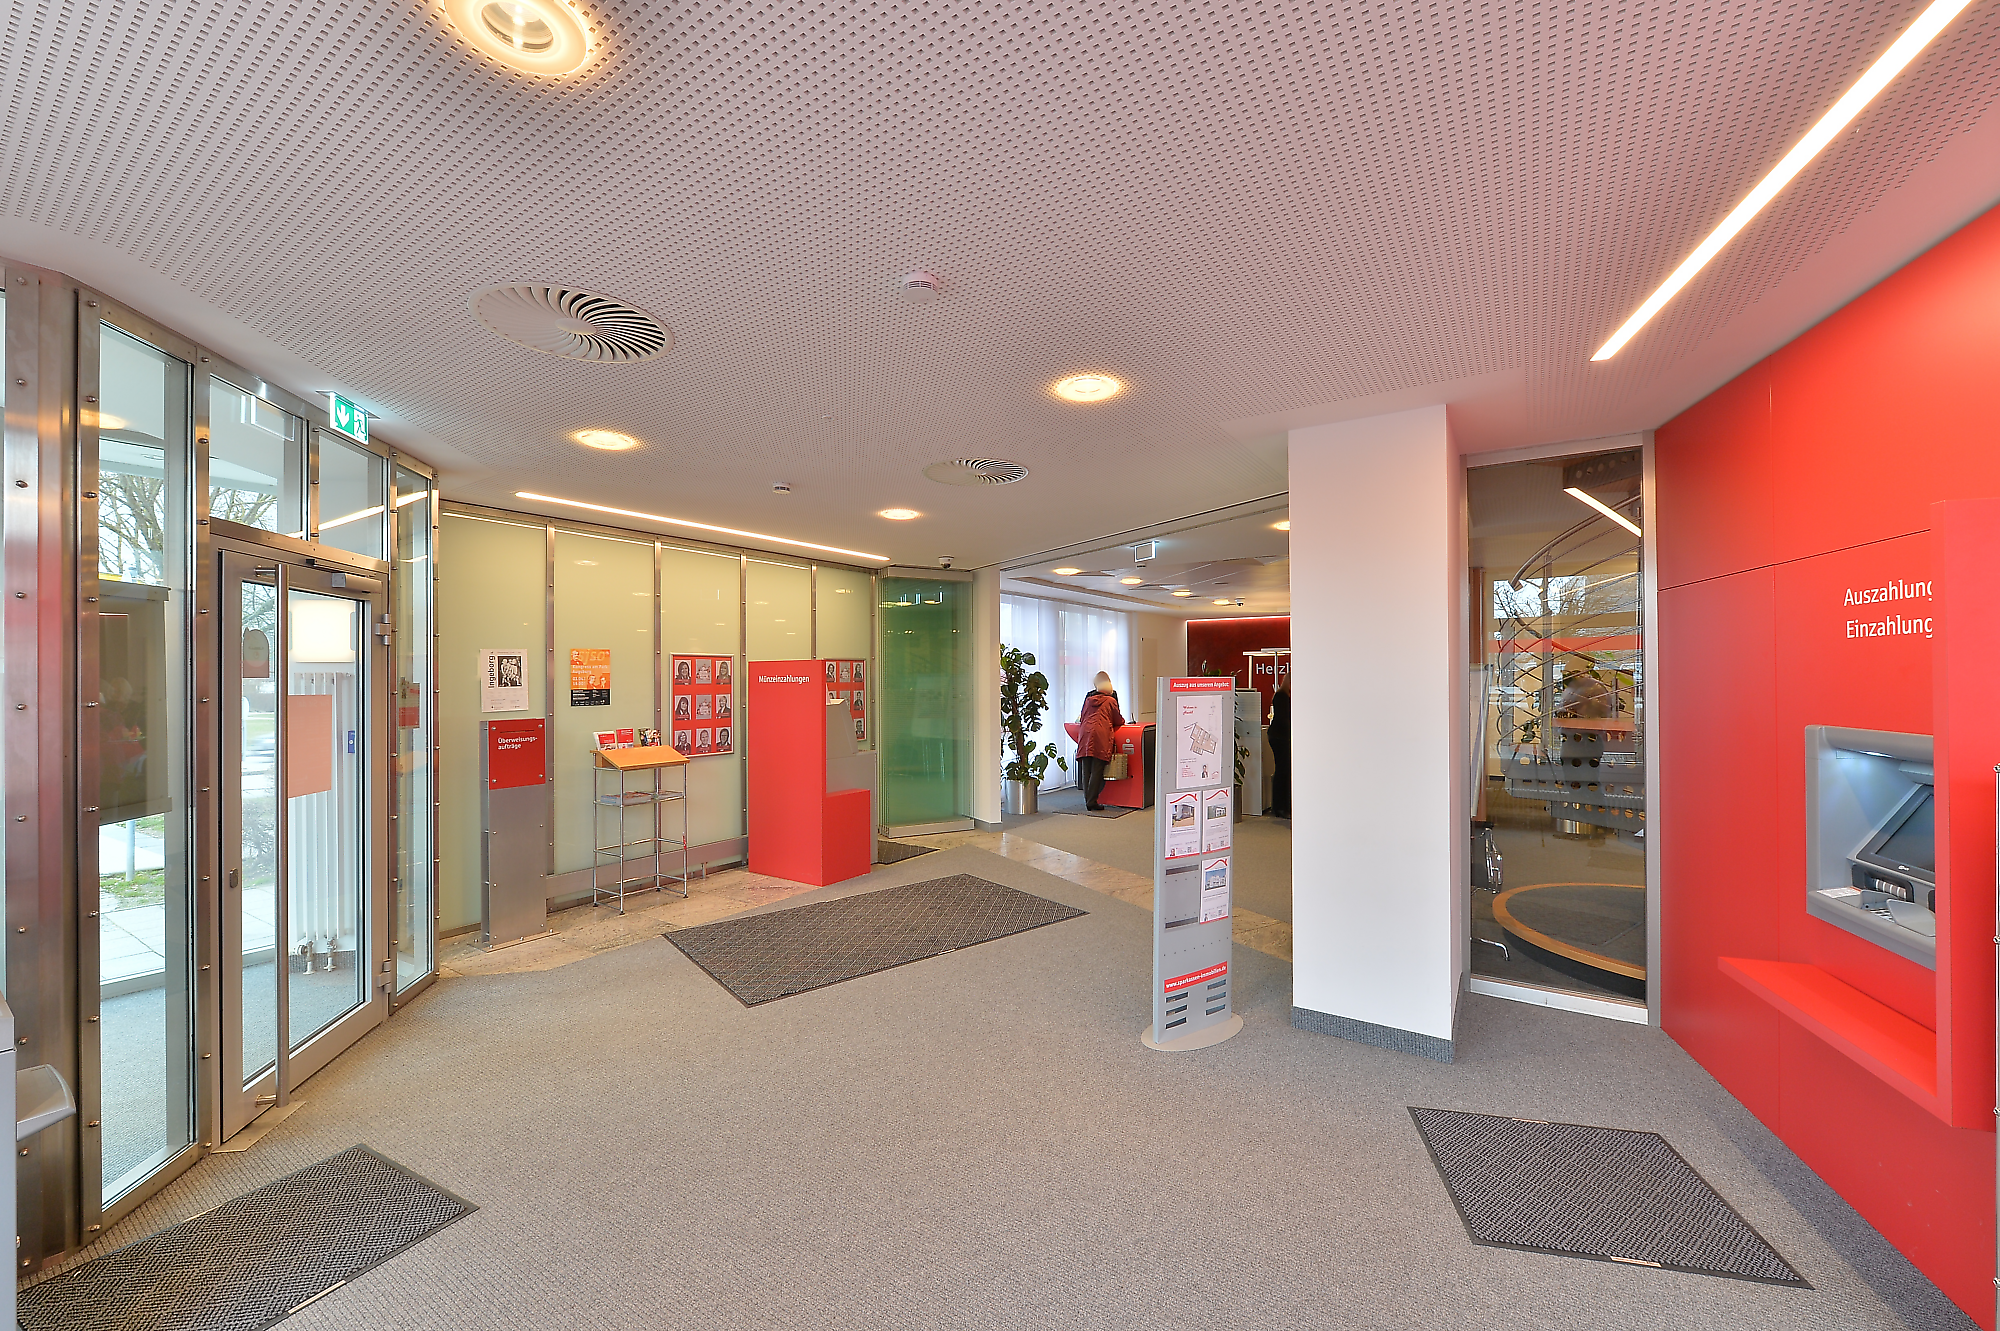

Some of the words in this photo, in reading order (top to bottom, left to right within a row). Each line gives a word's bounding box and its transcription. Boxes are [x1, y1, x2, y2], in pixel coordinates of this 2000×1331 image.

[487, 655, 496, 689] Ingeborg
[758, 674, 810, 685] Münzeinzahlungen
[497, 736, 538, 744] Überweisungs-
